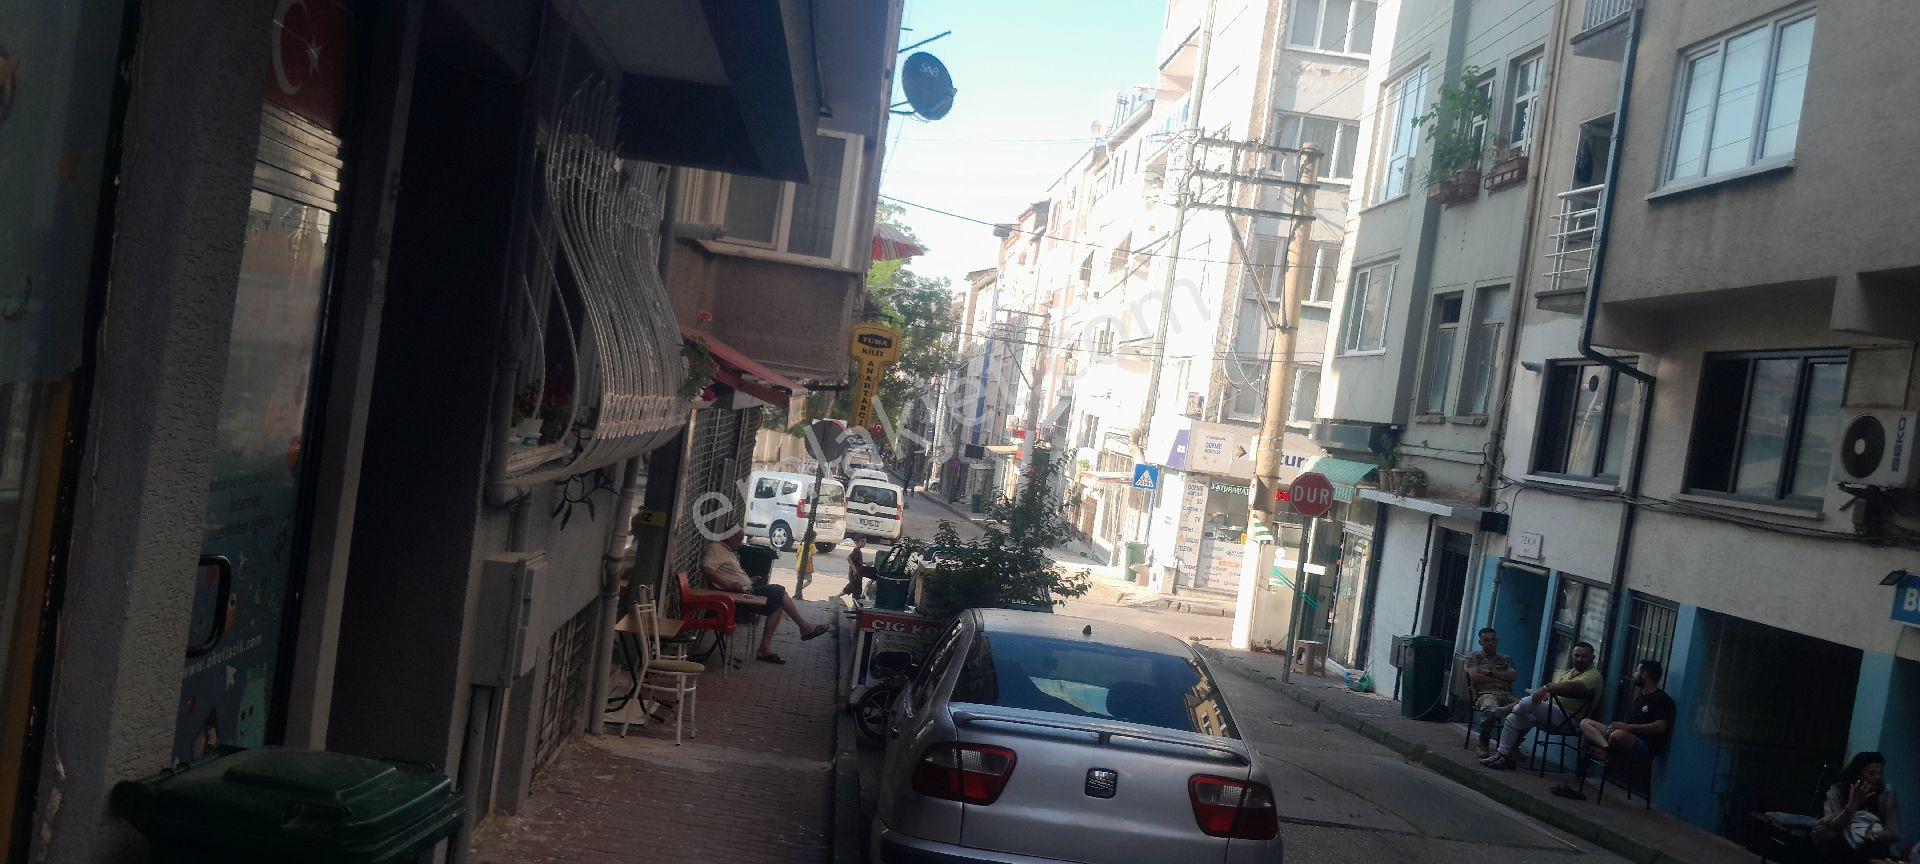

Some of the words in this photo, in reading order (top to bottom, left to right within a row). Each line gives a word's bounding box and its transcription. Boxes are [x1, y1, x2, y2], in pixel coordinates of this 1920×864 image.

[920, 63, 939, 77] SAB
[1891, 416, 1907, 472] BEKO
[1294, 486, 1330, 505] DUR
